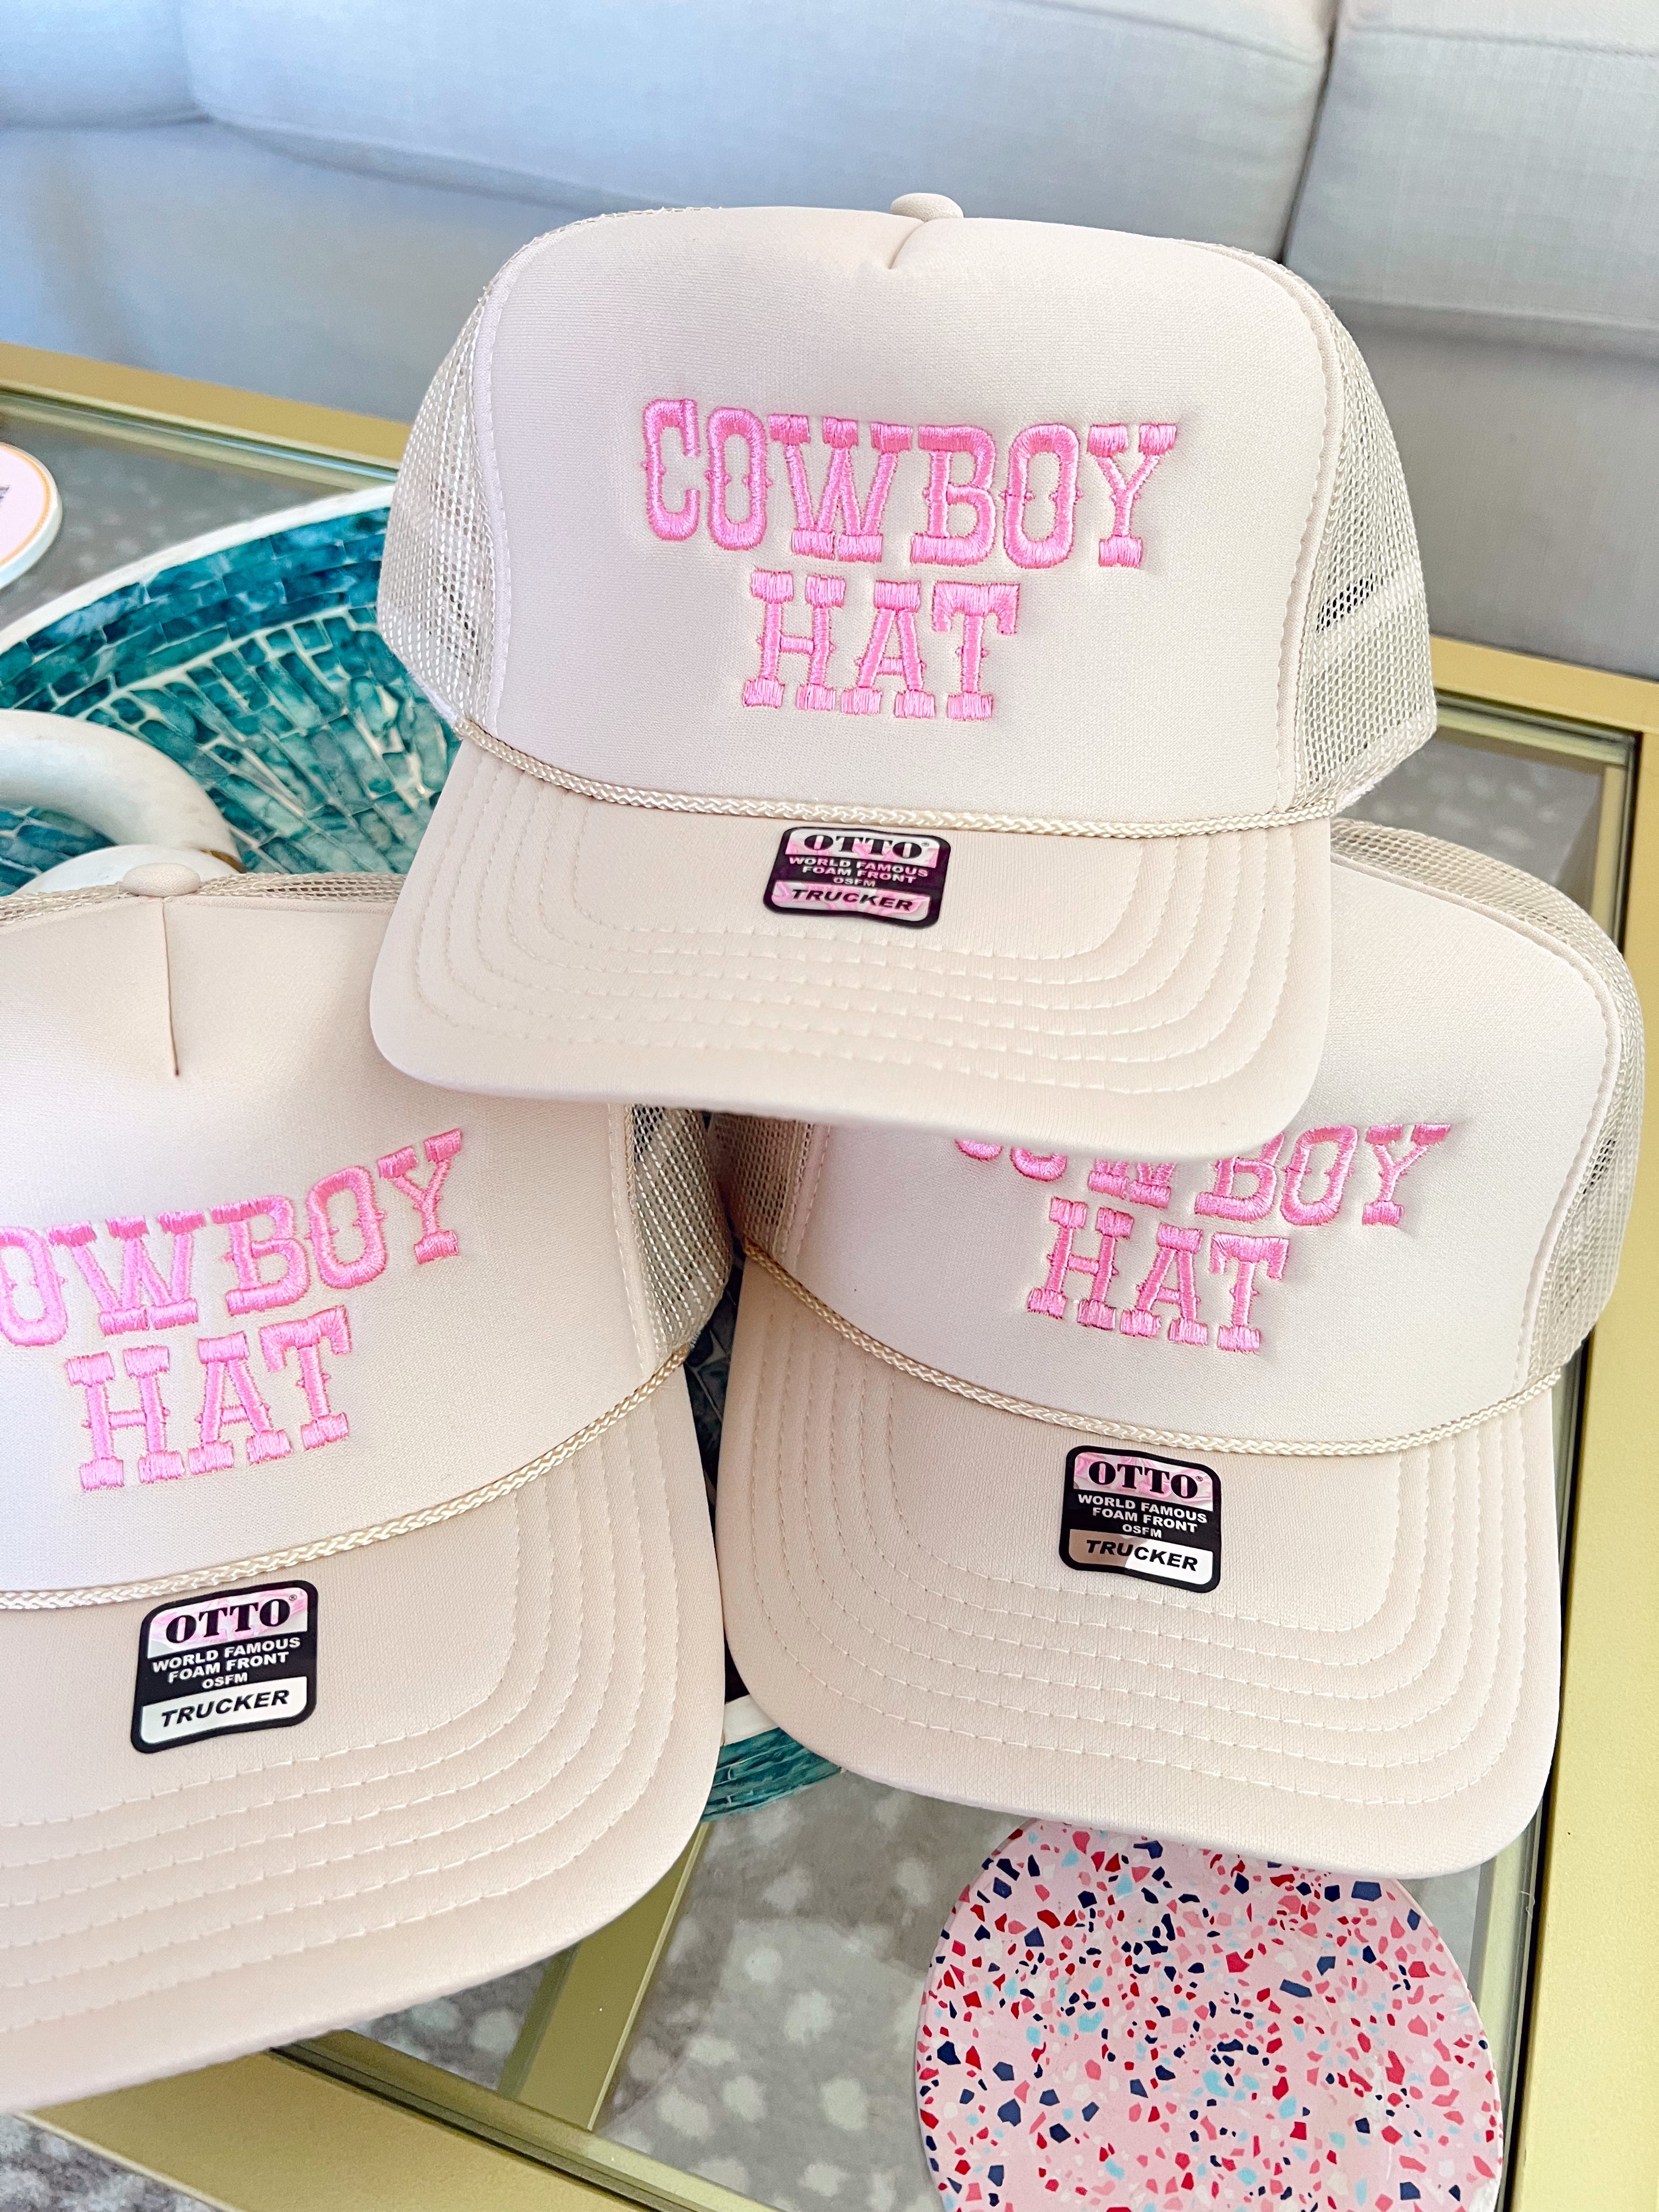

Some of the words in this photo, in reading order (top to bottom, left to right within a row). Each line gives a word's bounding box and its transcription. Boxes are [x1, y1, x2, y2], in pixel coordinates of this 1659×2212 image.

[641, 398, 1177, 569] COWBOY
[742, 569, 1020, 721] HAT
[789, 856, 850, 868] WORLD
[856, 861, 928, 877] FAMOUS
[803, 866, 850, 876] FOAM
[857, 870, 917, 884] FRONT
[833, 878, 876, 887] OSFM
[792, 889, 915, 911] TRUCKER
[1026, 1196, 1289, 1353] HAT
[65, 1304, 353, 1492] HAT
[1078, 1494, 1136, 1510] WORLD
[1141, 1502, 1207, 1523] FAMOUS
[1093, 1507, 1138, 1522] FOAM
[1143, 1514, 1197, 1533] FRONT
[1122, 1523, 1162, 1538] OSFM
[1086, 1539, 1198, 1571] TRUCKER
[153, 1650, 219, 1673] WORLD
[224, 1637, 301, 1658] FAMOUS
[168, 1662, 221, 1684] FOAM
[226, 1651, 289, 1672] FRONT
[202, 1672, 247, 1689] OSFM
[162, 1689, 290, 1728] TRUCKER
